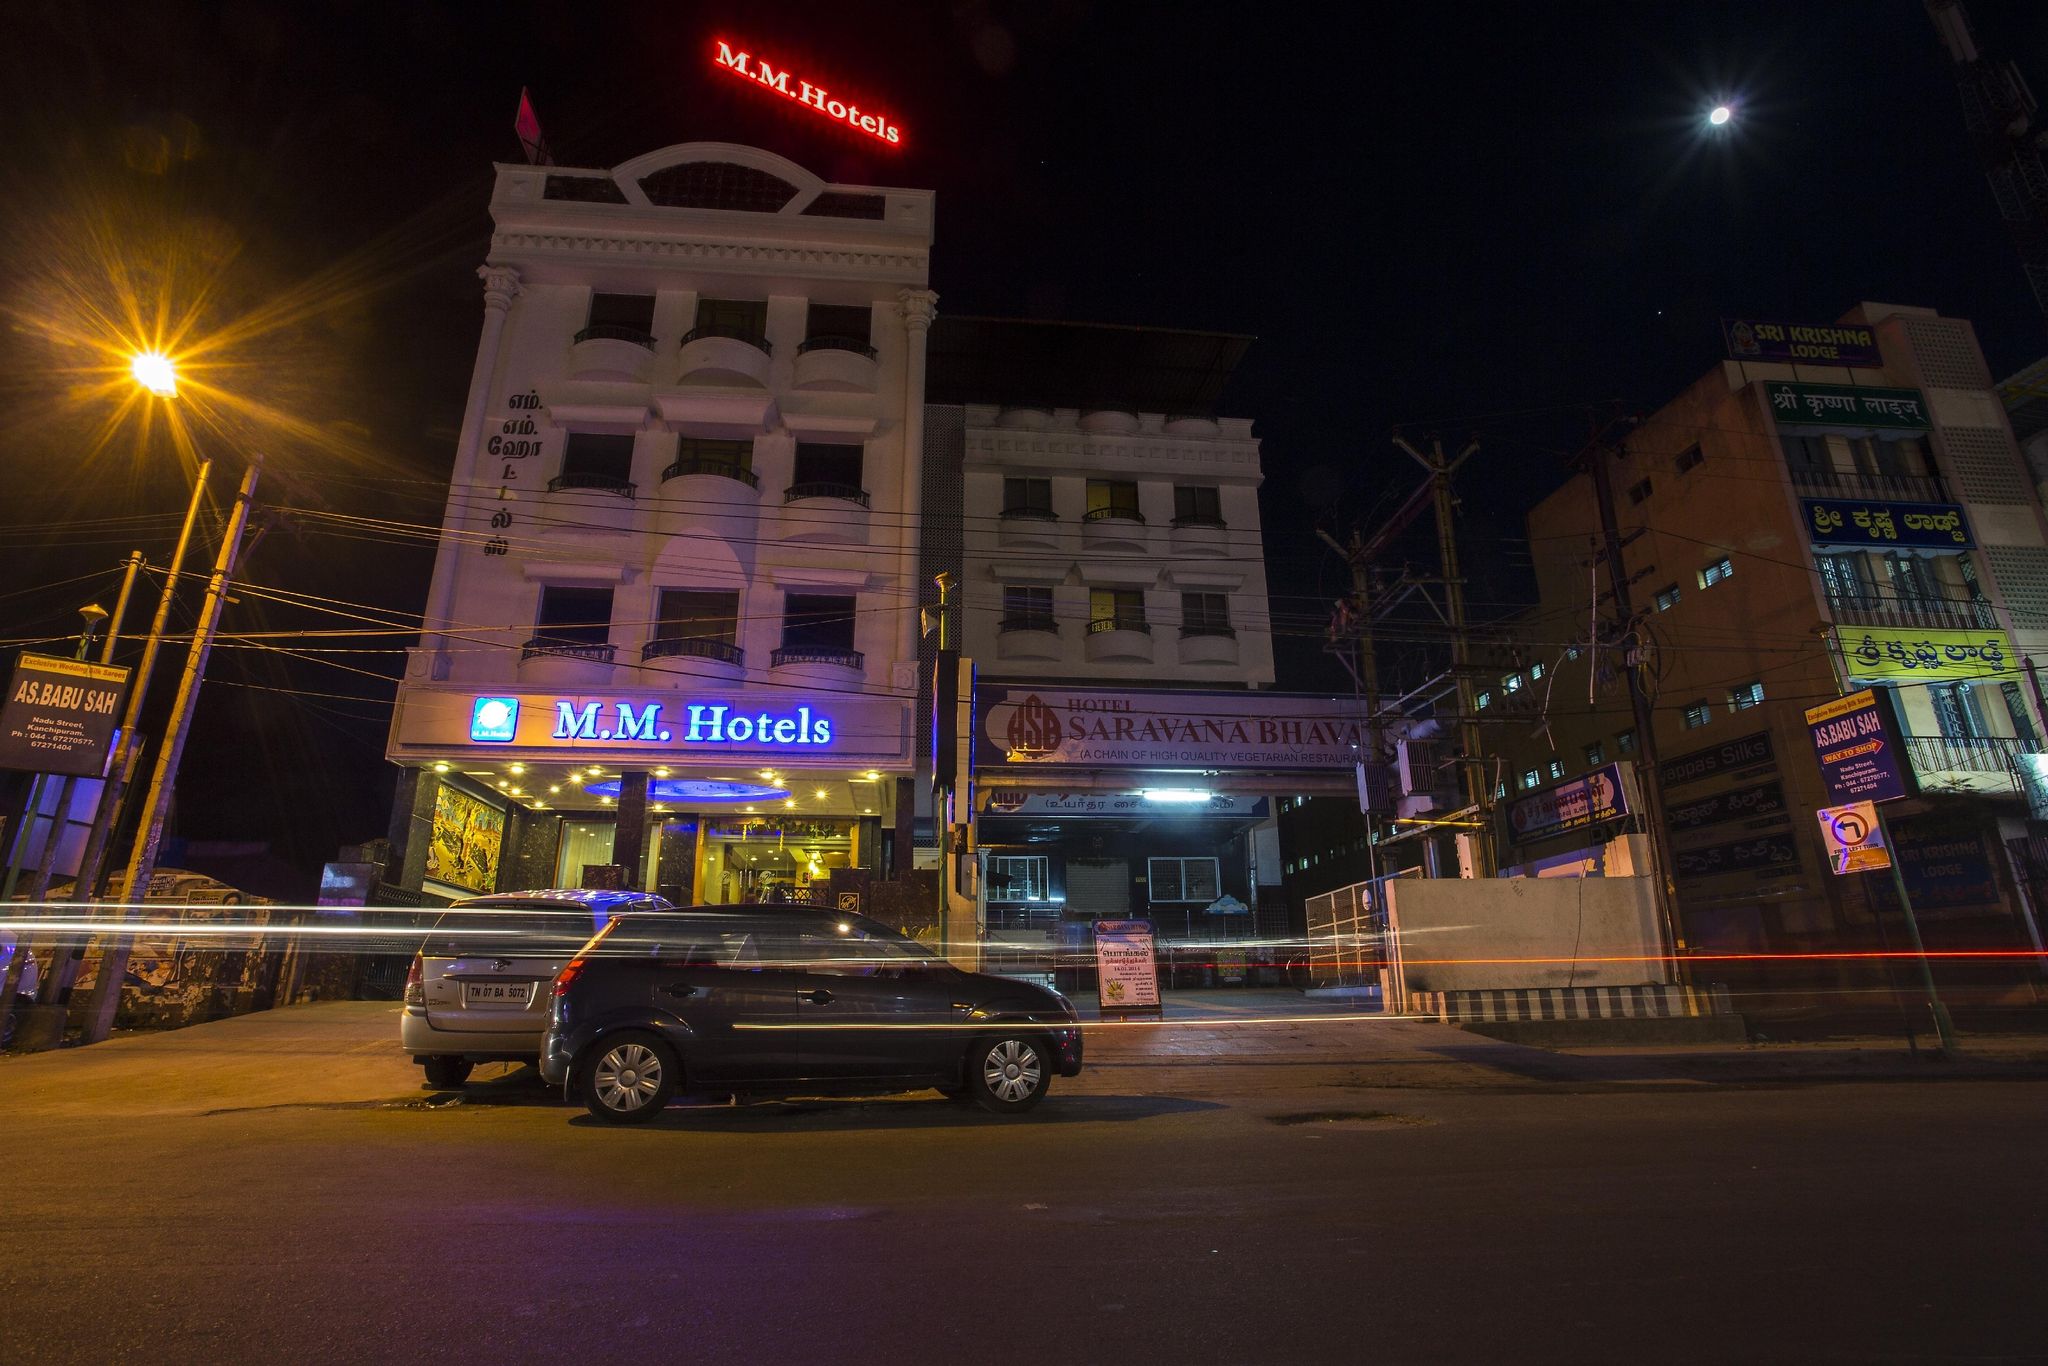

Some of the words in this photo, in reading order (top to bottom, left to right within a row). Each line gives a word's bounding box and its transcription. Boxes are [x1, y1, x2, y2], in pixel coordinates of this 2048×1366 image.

[716, 41, 900, 143] M.M.Hotels
[1754, 324, 1785, 342] SRI
[1789, 325, 1873, 347] KRISHNA
[1789, 344, 1840, 360] LODGE
[1773, 385, 1799, 410] श्री
[1802, 394, 1856, 417] कृष्णा
[1813, 505, 1844, 534] ಶ್ರೀ
[24, 657, 57, 669] Exclusive
[14, 680, 84, 710] AS.BABU
[84, 690, 118, 714] SAH
[1068, 698, 1137, 713] HOTEL
[32, 716, 55, 725] Nadu
[552, 701, 671, 741] M.M.
[684, 706, 831, 744] Hotels
[1069, 716, 1250, 744] SARAVANA
[1258, 719, 1374, 746] BHAVA
[1815, 718, 1858, 748] AS.BABU
[1857, 711, 1881, 735] SAH
[11, 730, 23, 738] Ph
[30, 732, 46, 740] 044
[31, 740, 72, 751] 67271404
[1079, 750, 1092, 760] (A
[1094, 750, 1129, 760] CHAIN
[1131, 750, 1146, 760] OF
[1150, 750, 1177, 761] HIGH
[1181, 751, 1231, 762] QUALITY
[1231, 752, 1299, 763] VEGETARIAN
[1721, 740, 1765, 764] Silks
[1824, 753, 1841, 763] WAY
[1843, 749, 1854, 758] TO
[1856, 742, 1877, 755] SHOP
[1840, 765, 1855, 773] Nadu
[1901, 849, 1920, 863] SRI
[1922, 841, 1980, 859] KRISHNA
[1921, 863, 1964, 878] LODGE
[471, 987, 480, 997] TN
[483, 987, 492, 997] 07
[494, 987, 504, 997] BA
[508, 987, 526, 998] 5072
